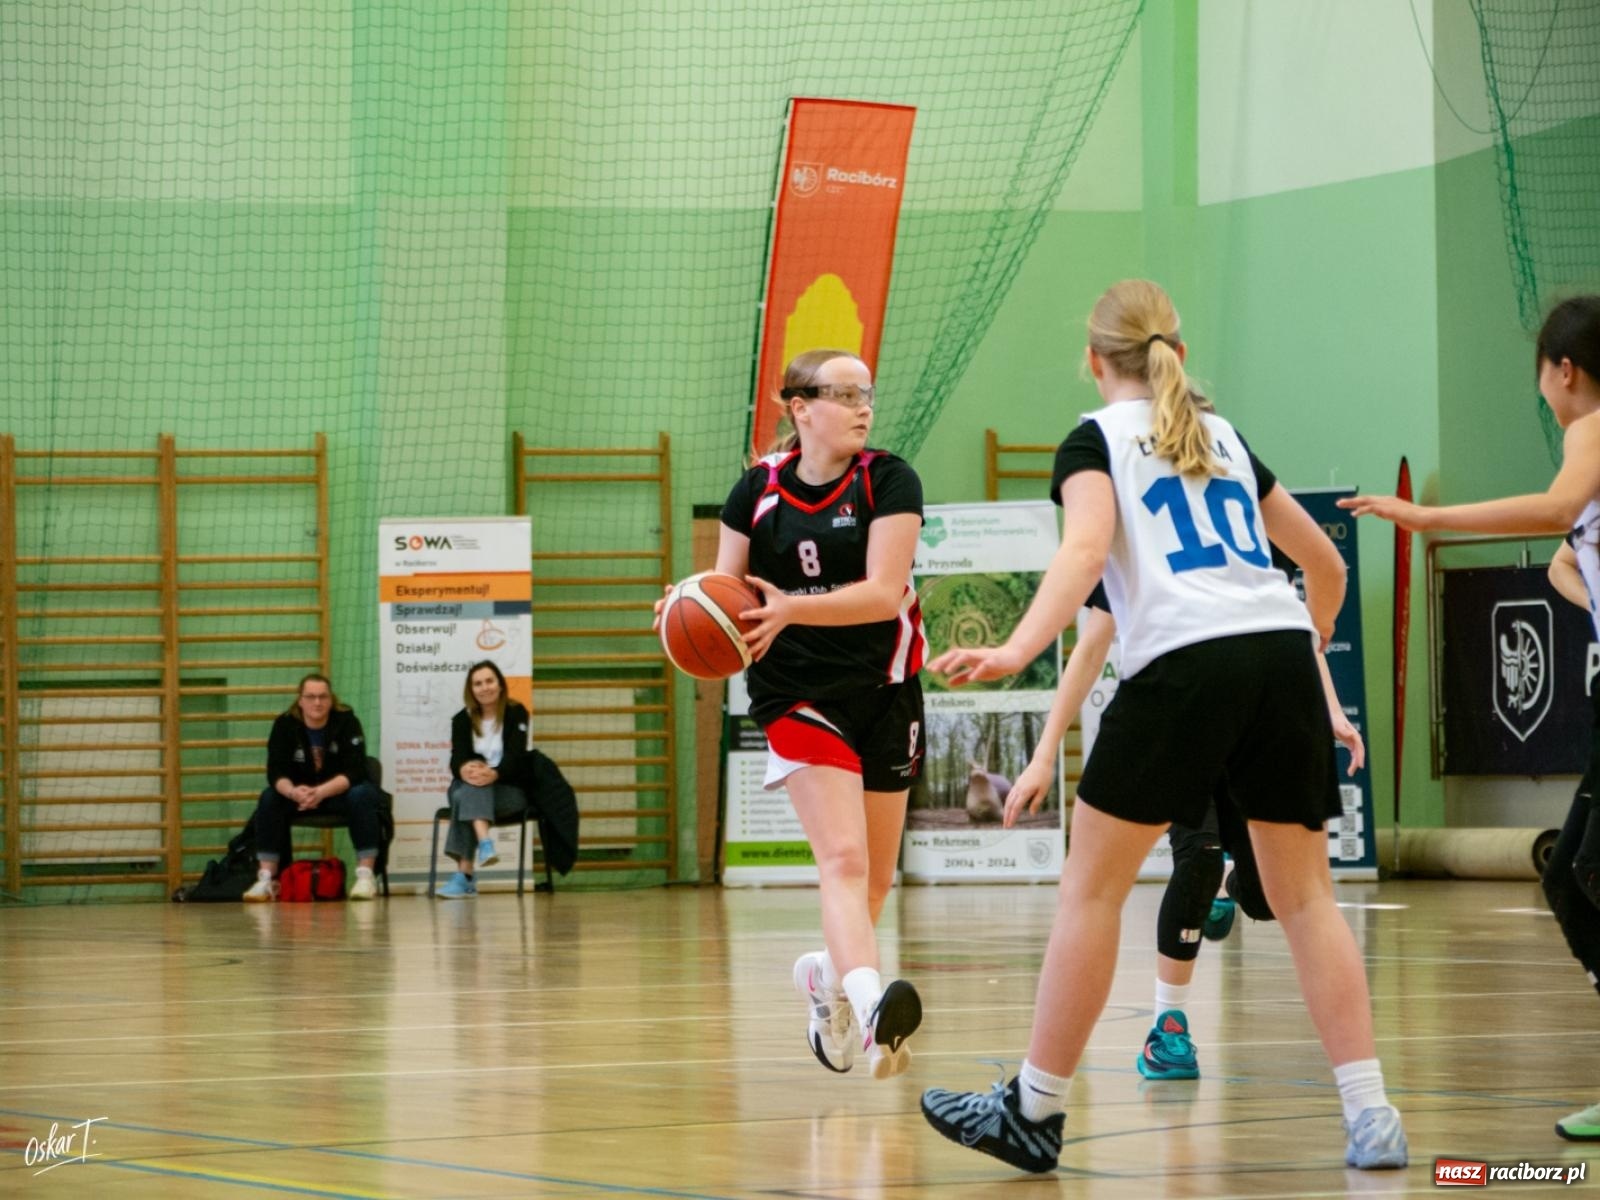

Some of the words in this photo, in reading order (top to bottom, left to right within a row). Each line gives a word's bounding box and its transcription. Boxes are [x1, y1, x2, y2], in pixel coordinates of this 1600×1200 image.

[827, 167, 898, 189] Racibórz
[1142, 475, 1270, 574] 10
[394, 535, 452, 551] SOWA
[798, 540, 821, 577] 8
[396, 584, 490, 598] Eksperymentuj!
[396, 603, 462, 617] Sprawdzaj!
[396, 622, 457, 636] Obserwuj!
[396, 642, 440, 656] Działaj!
[909, 721, 919, 758] 8
[944, 858, 975, 869] 2004
[987, 857, 1017, 868] 2024
